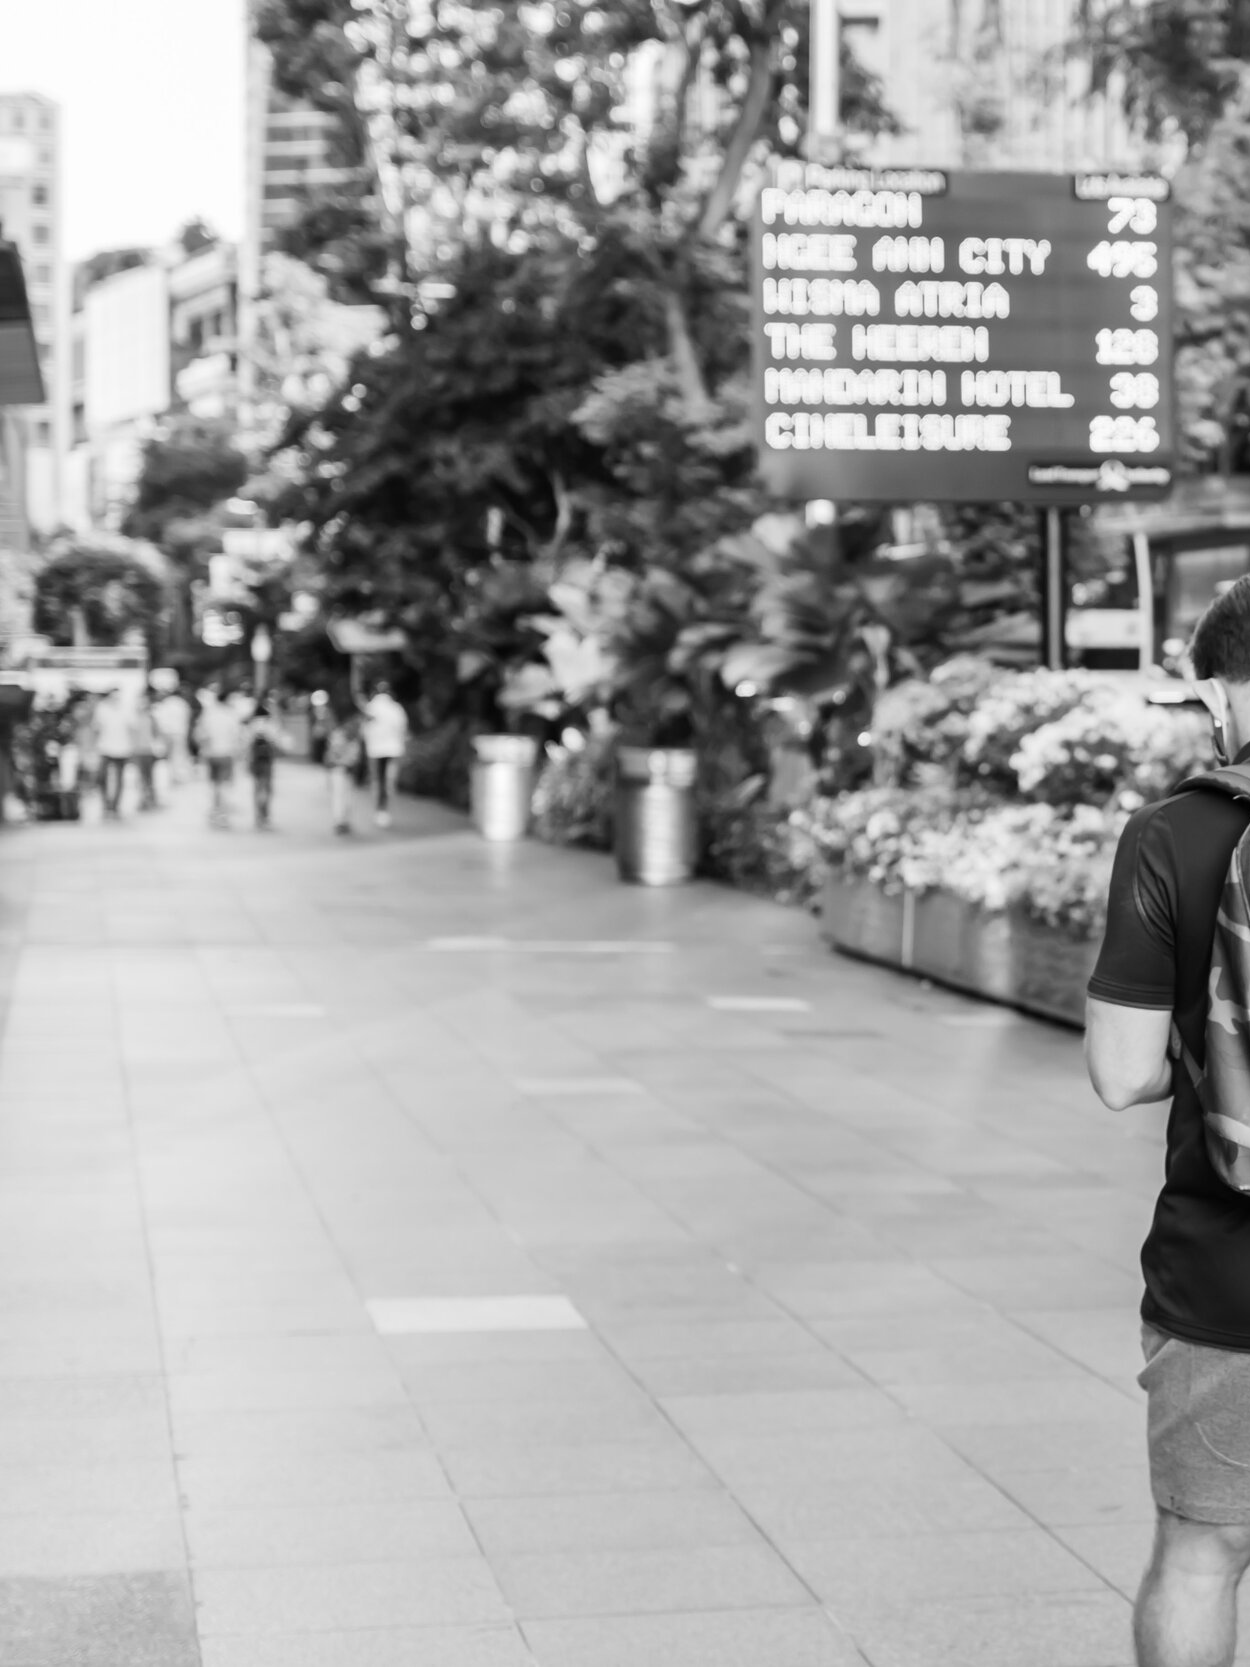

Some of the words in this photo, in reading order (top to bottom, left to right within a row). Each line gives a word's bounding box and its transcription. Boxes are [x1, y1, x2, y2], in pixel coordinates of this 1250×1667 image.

[762, 188, 922, 228] PARAGON
[1108, 197, 1157, 234] 73
[762, 233, 857, 272] NGEE
[872, 235, 944, 273] ANN
[959, 237, 1052, 275] CITY
[1087, 240, 1158, 278] 495
[763, 277, 880, 316] WISMA
[895, 280, 1010, 319] ATRIA
[1130, 285, 1158, 322] 3
[764, 322, 837, 361] THE
[852, 324, 989, 363] HEEREN
[765, 367, 947, 406] MANDARIN
[961, 370, 1075, 408] HOTEL
[766, 412, 1012, 451] CINELEISURE
